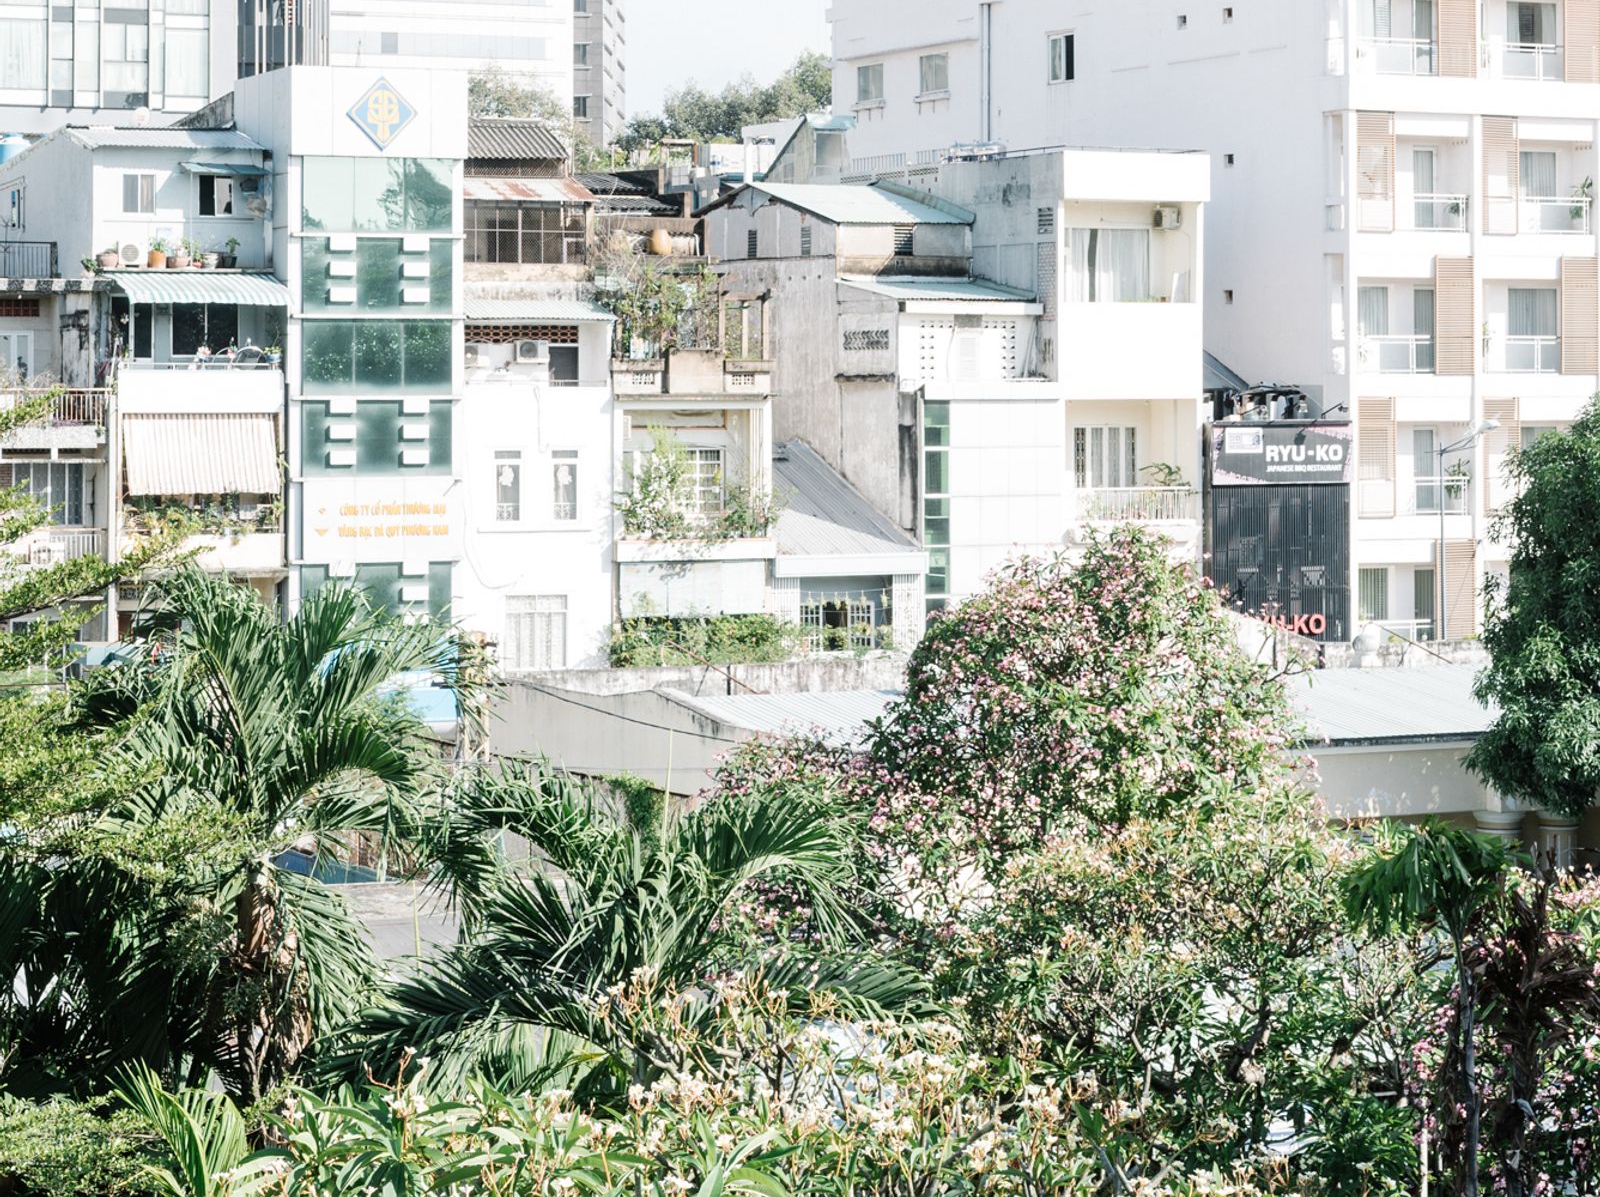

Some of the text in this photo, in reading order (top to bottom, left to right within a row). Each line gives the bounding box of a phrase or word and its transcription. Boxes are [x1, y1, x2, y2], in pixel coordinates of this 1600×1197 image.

[1265, 444, 1343, 462] RYU-KO
[1266, 464, 1294, 473] JAPANESE
[1306, 464, 1343, 472] RESTAURANT
